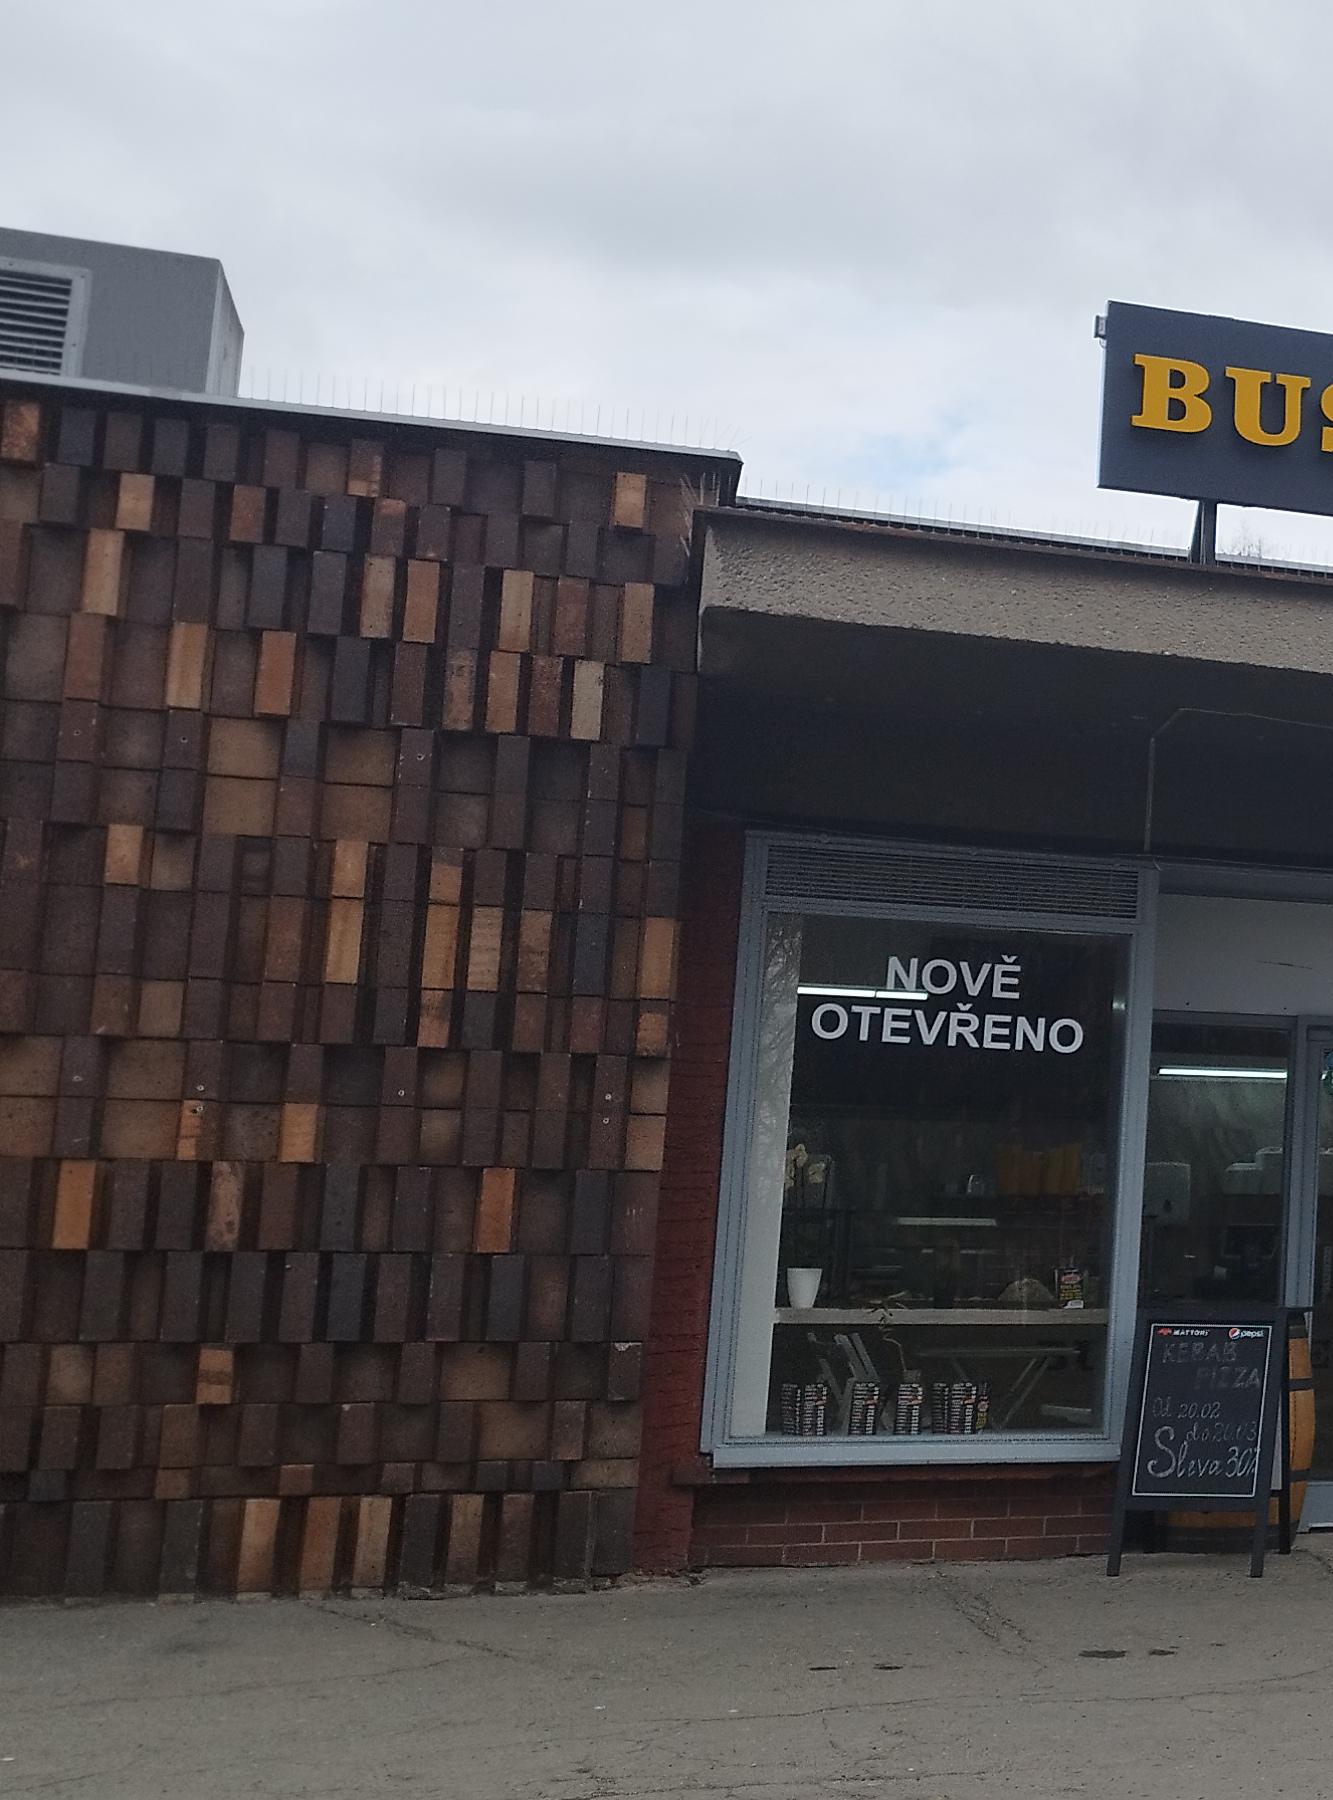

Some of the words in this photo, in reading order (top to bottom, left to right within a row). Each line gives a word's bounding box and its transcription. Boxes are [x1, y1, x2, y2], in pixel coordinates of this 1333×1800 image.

[886, 954, 1022, 1001] NOVĚ
[811, 1002, 1085, 1054] OTEVŘENO
[1147, 1426, 1223, 1478] Sleva
